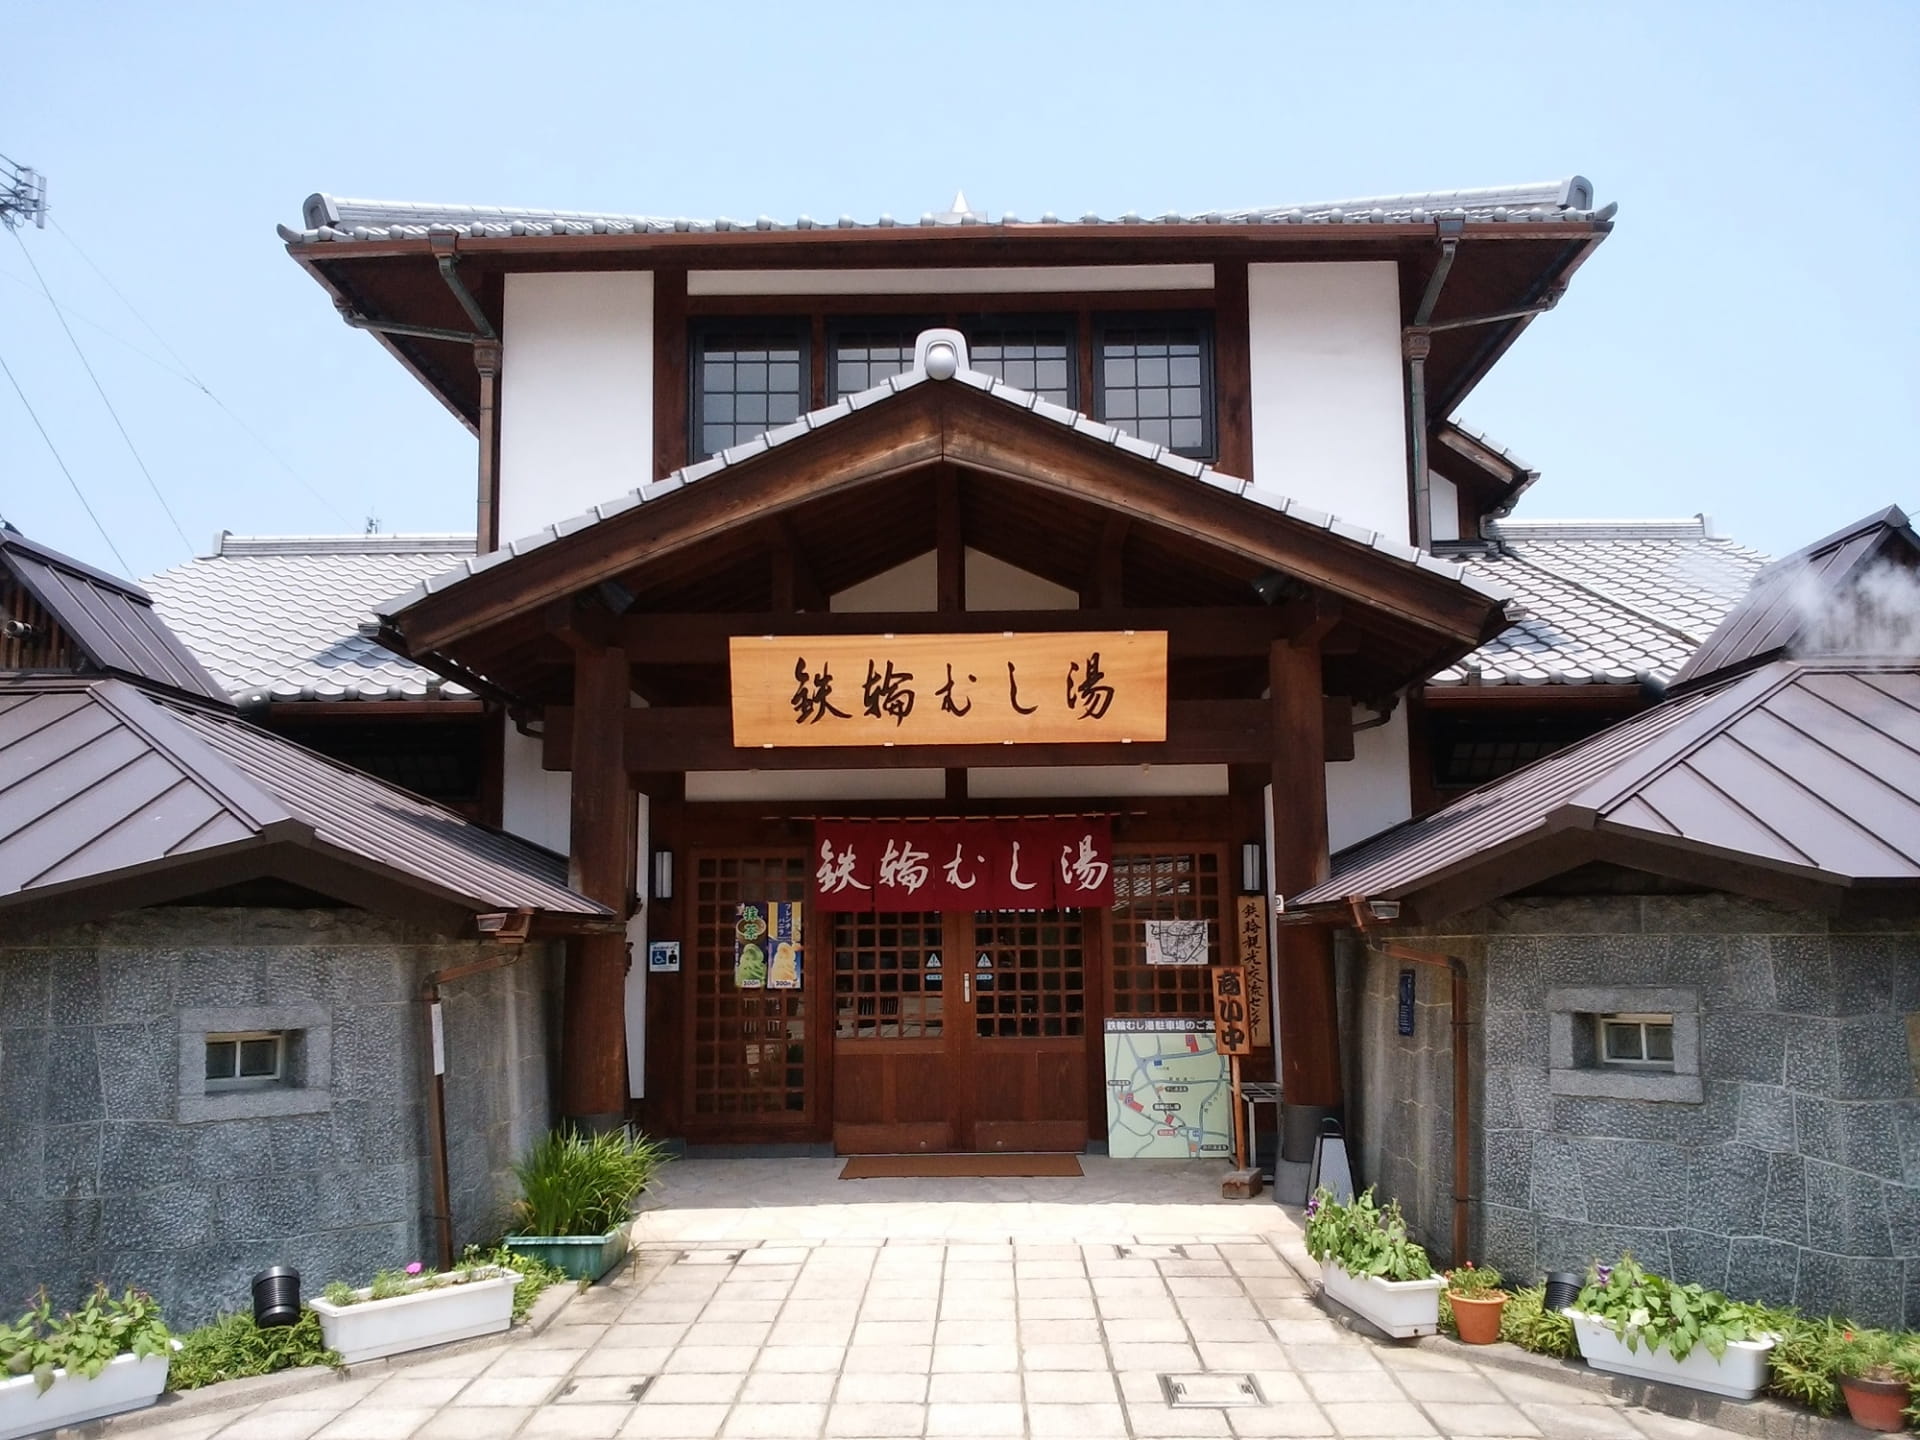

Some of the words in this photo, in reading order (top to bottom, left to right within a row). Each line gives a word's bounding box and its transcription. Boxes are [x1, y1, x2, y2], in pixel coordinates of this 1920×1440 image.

[790, 652, 1114, 727] 鉄輪むし湯
[816, 834, 1109, 895] 鉄輪むし湯
[743, 906, 759, 940] 抹茶
[1106, 1020, 1216, 1031] 鉄輪むし湯駐車場のご案
